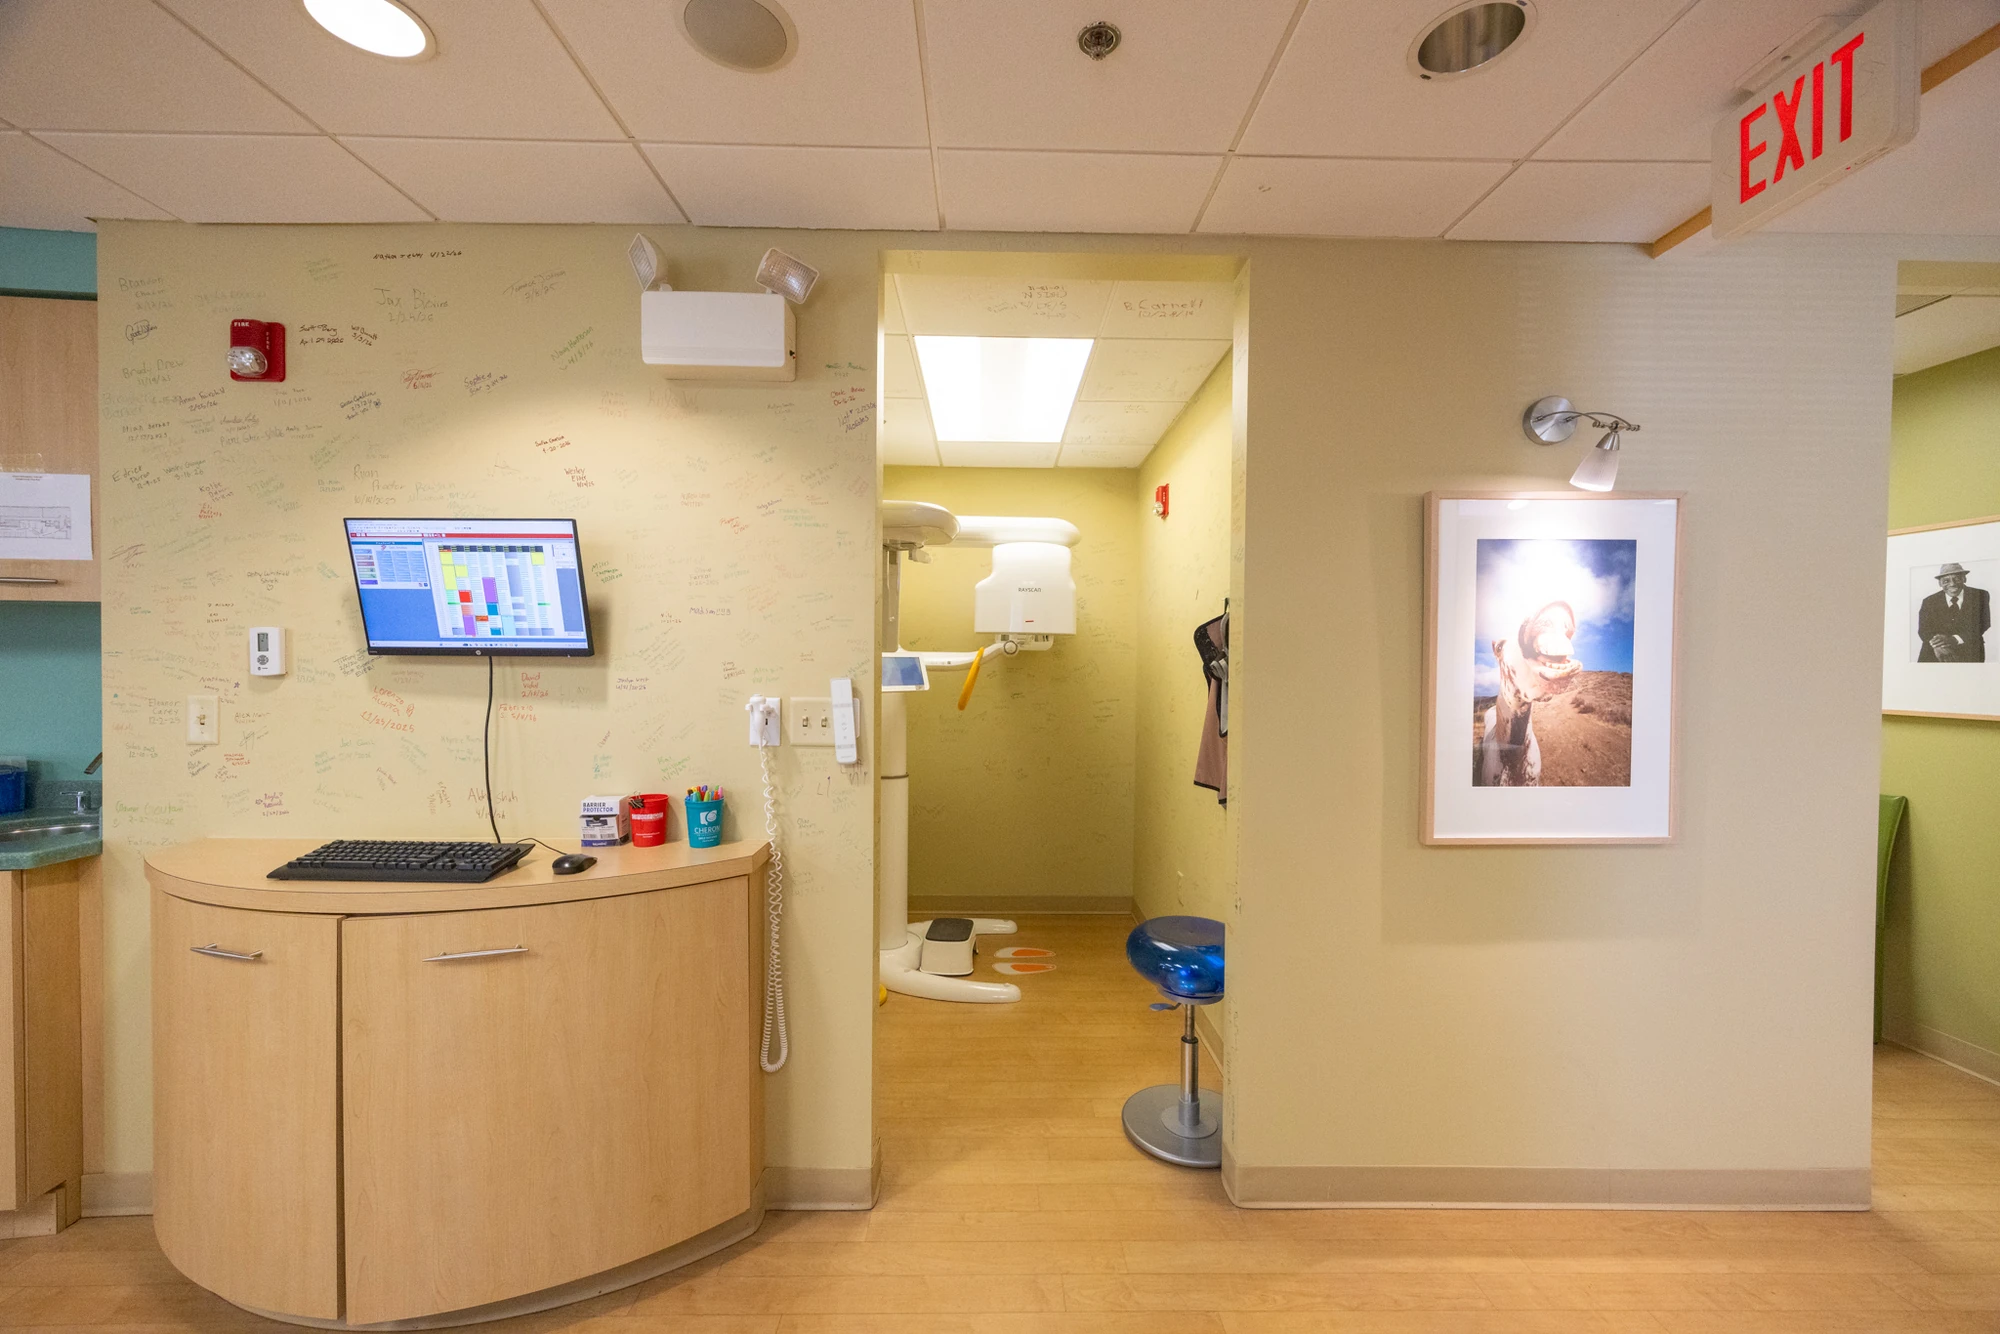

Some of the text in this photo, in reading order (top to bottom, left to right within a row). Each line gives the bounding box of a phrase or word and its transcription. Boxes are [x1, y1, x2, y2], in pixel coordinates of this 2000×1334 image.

[1740, 32, 1864, 204] EXIT
[521, 672, 541, 682] David
[148, 698, 181, 707] Eleanor
[373, 686, 404, 705] Lorenzo
